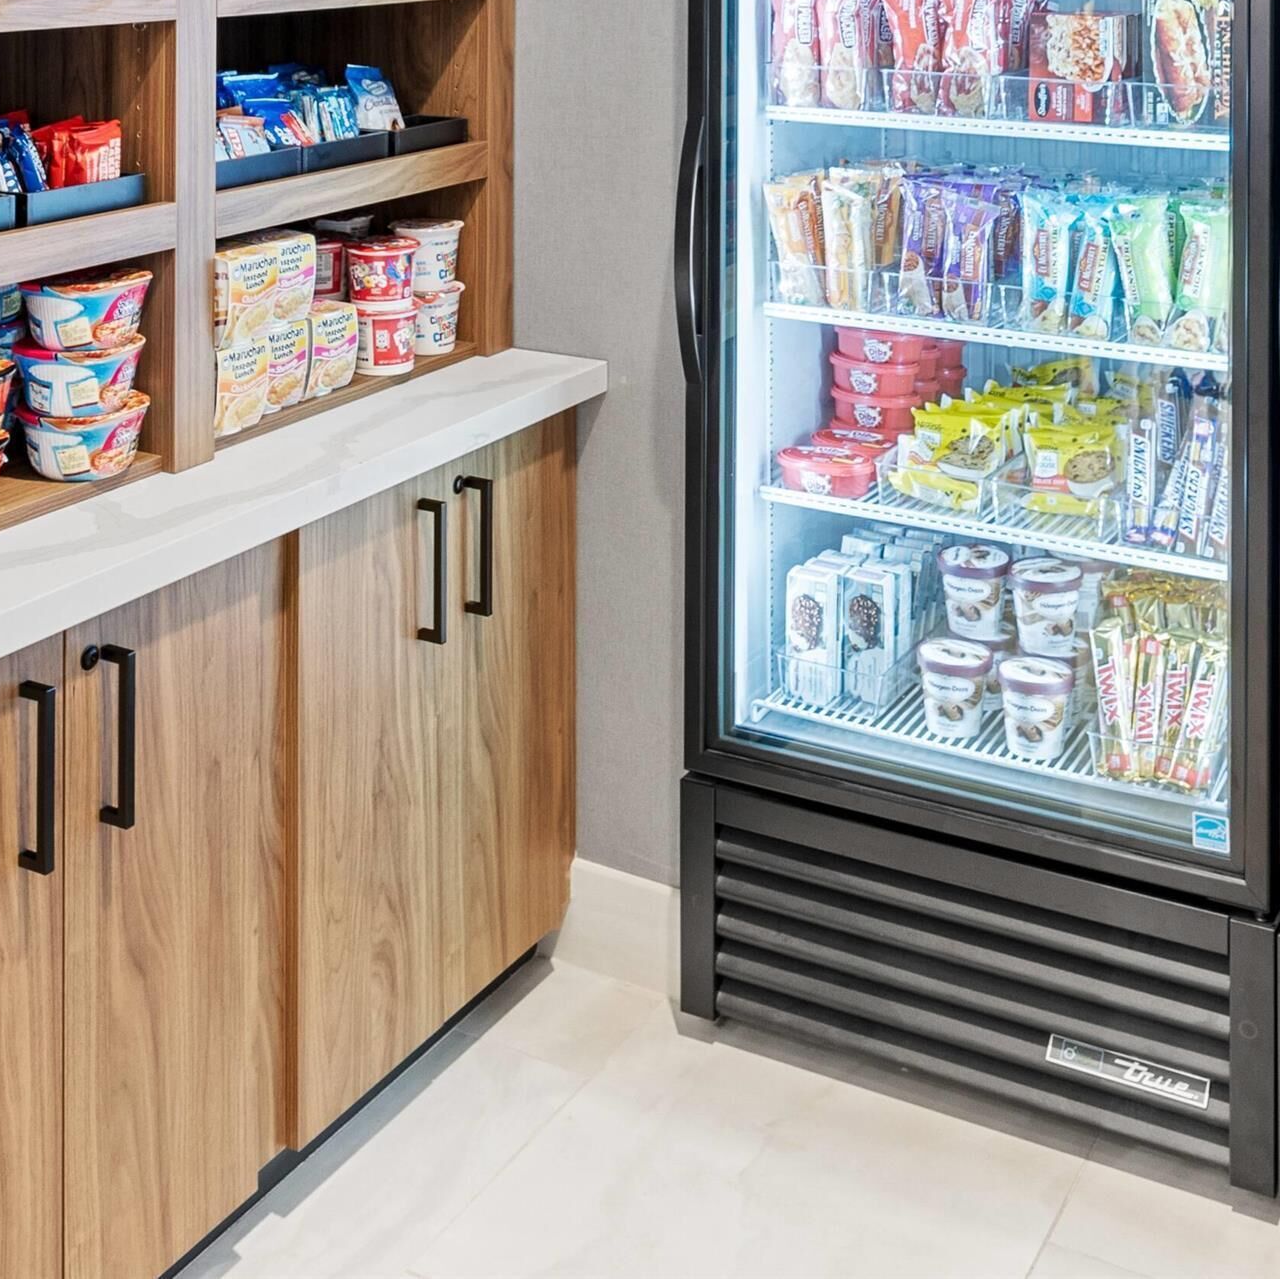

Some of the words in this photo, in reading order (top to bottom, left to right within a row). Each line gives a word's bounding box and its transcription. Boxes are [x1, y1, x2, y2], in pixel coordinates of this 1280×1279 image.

[1160, 401, 1176, 463] SNICKERS
[1133, 437, 1147, 499] SNICKERS
[1097, 655, 1121, 723] TWIX
[1136, 682, 1154, 744] TWIX
[1165, 663, 1187, 728] TWIX
[1189, 674, 1215, 739] TWIX
